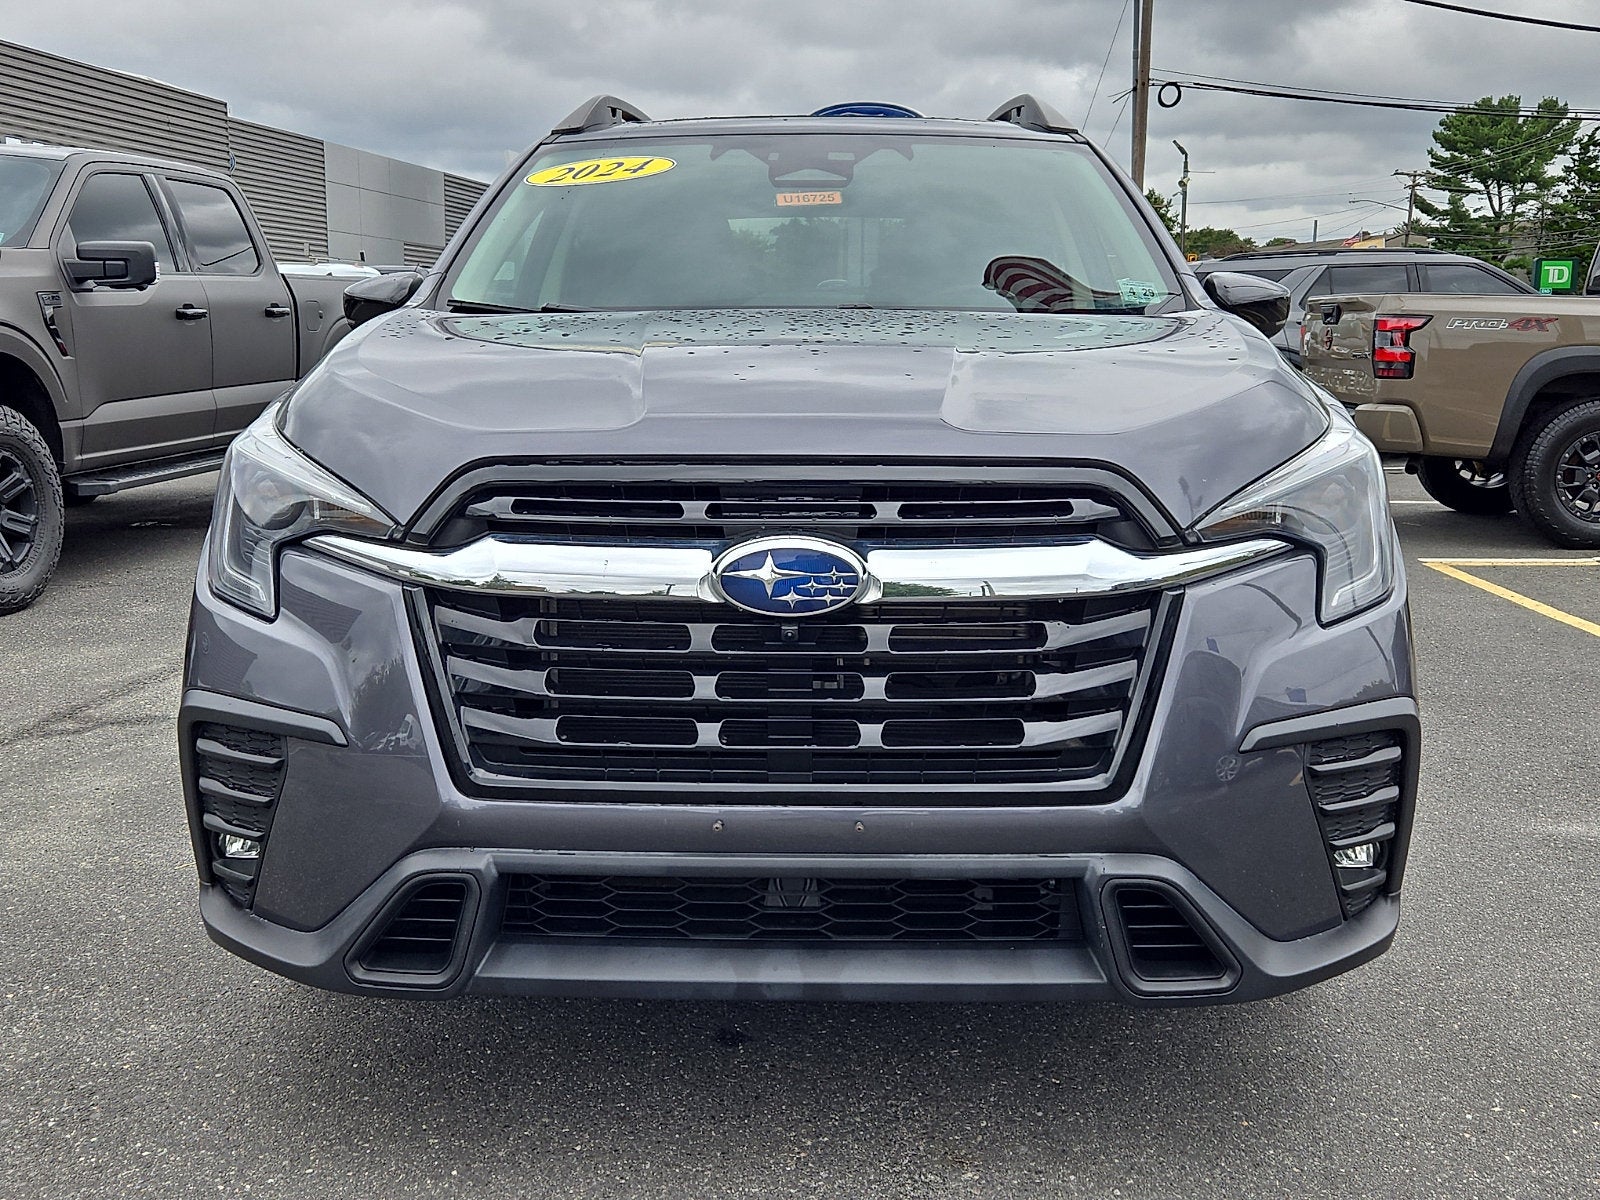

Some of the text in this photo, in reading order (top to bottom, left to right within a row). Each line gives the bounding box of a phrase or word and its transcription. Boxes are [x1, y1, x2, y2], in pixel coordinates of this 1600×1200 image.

[544, 158, 655, 184] 2024
[783, 193, 835, 204] U16725
[1544, 265, 1569, 284] TD
